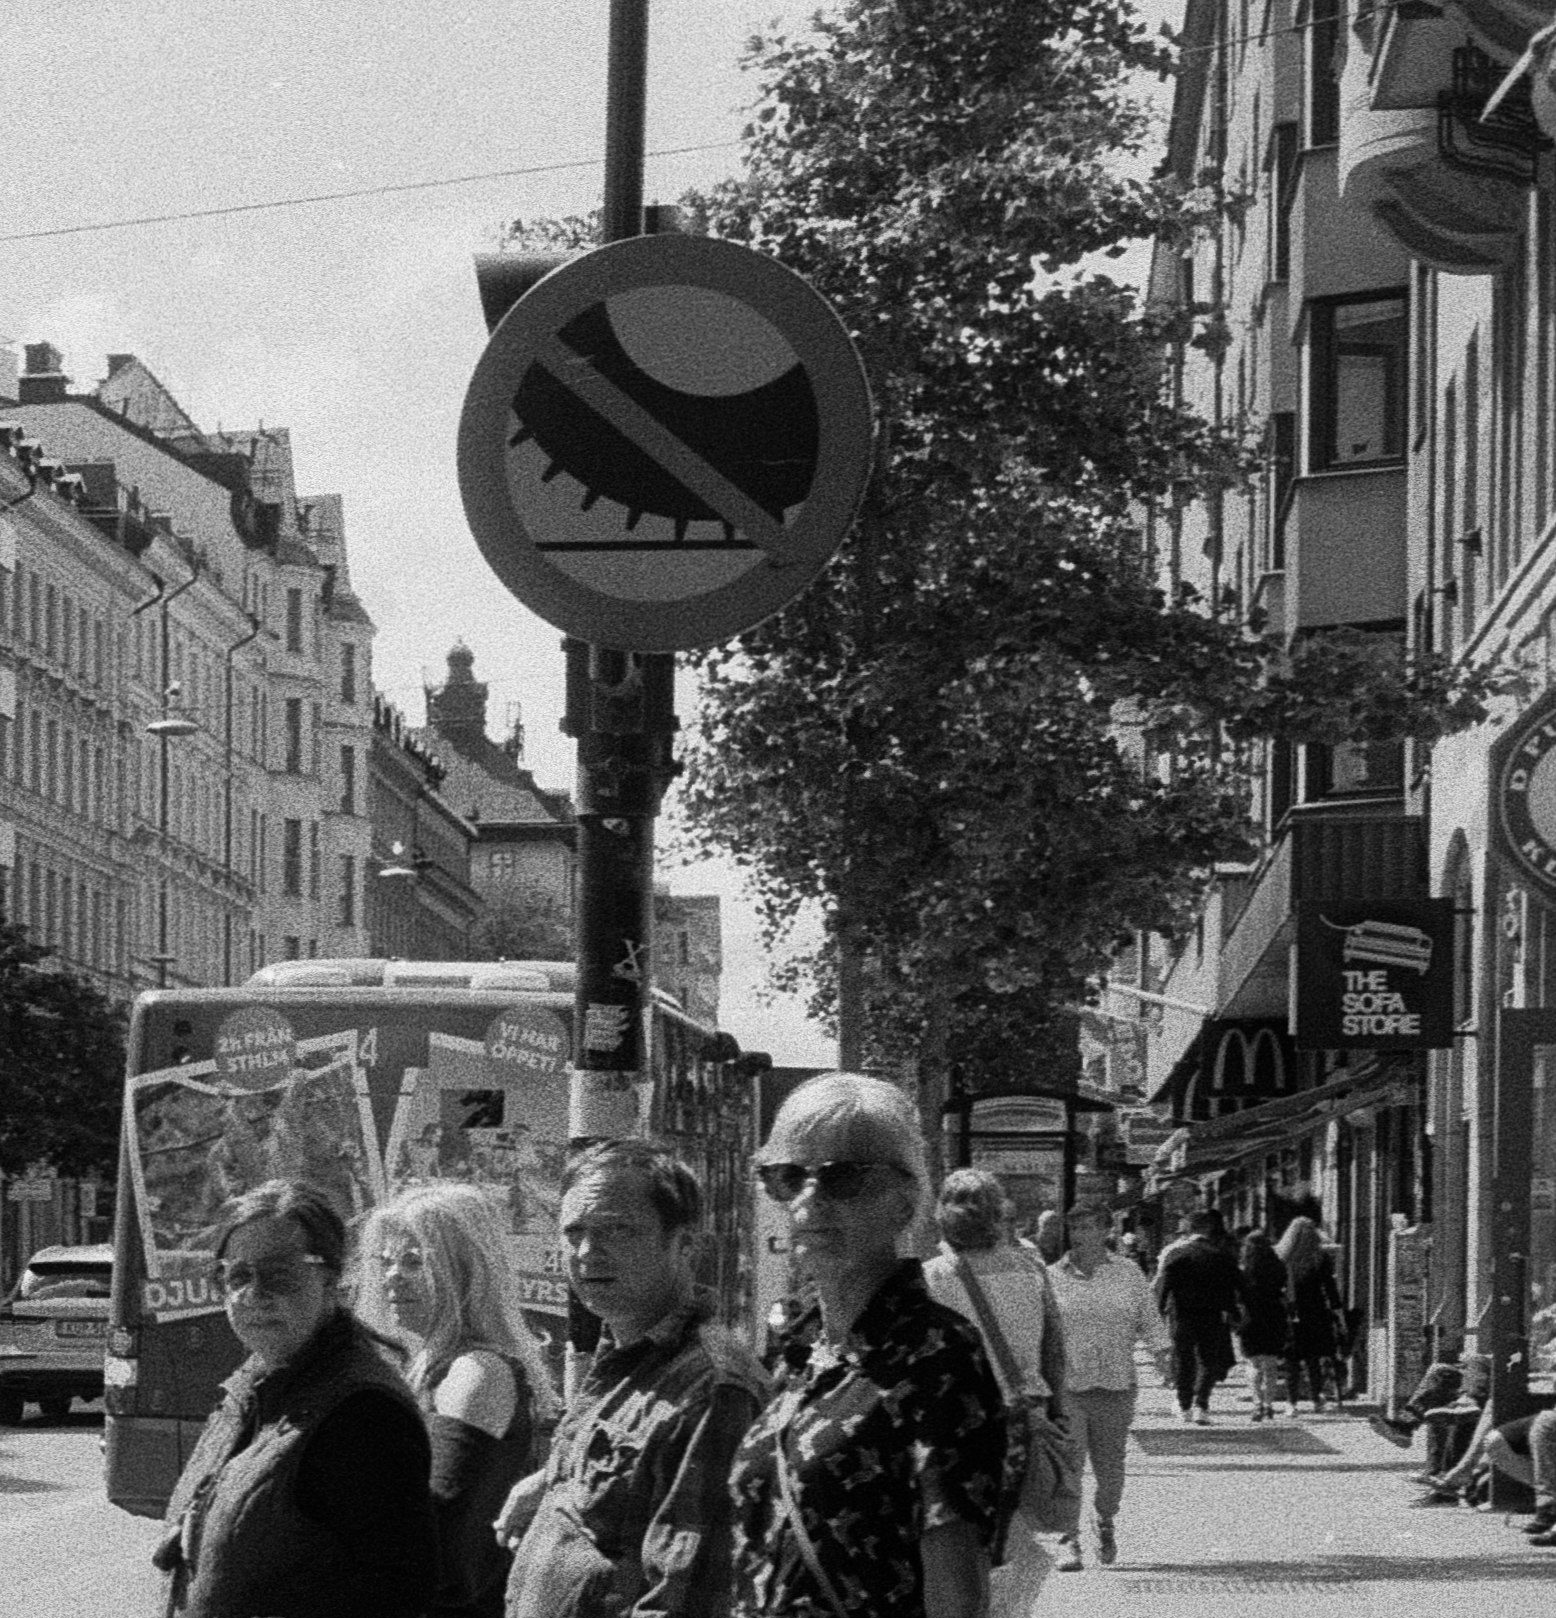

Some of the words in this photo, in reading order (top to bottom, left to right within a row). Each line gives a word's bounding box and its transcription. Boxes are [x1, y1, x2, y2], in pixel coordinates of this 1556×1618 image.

[1341, 970, 1388, 991] THE
[1341, 992, 1407, 1014] SOFA
[500, 1021, 519, 1041] VI
[520, 1028, 560, 1052] HAR
[1341, 1014, 1421, 1036] STORE
[244, 1026, 294, 1049] FRÅN
[227, 1049, 290, 1073] STHLM
[145, 1278, 219, 1308] DJU
